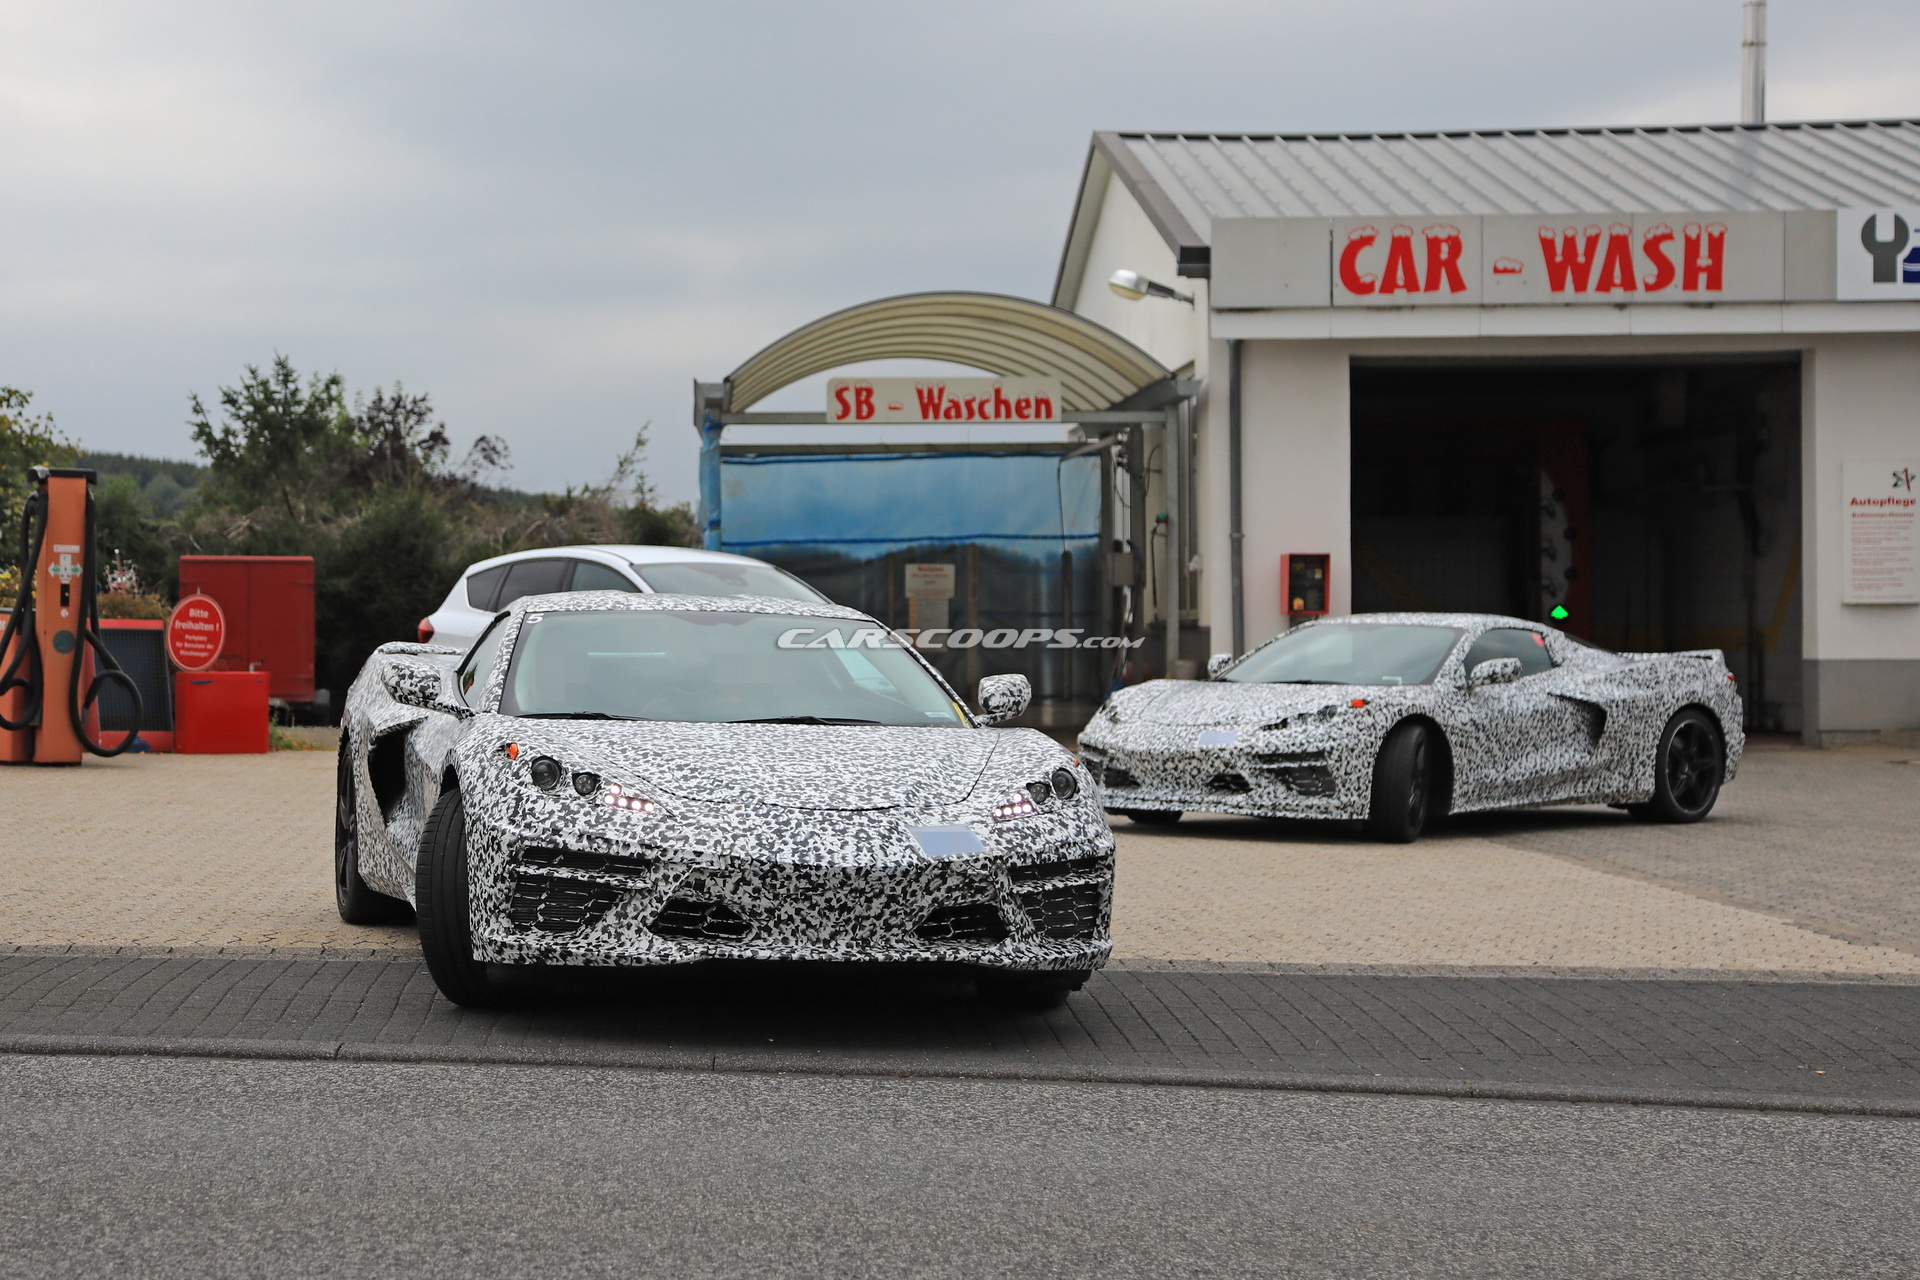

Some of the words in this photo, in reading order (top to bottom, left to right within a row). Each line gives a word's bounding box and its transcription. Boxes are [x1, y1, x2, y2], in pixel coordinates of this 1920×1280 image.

[1339, 225, 1468, 294] CAR
[1538, 222, 1728, 293] WASH
[834, 380, 876, 420] SB
[915, 380, 1054, 420] Waschen
[1850, 496, 1916, 508] Autopflege
[188, 607, 209, 618] Bitte
[526, 613, 545, 624] 5
[175, 620, 214, 631] freihalten
